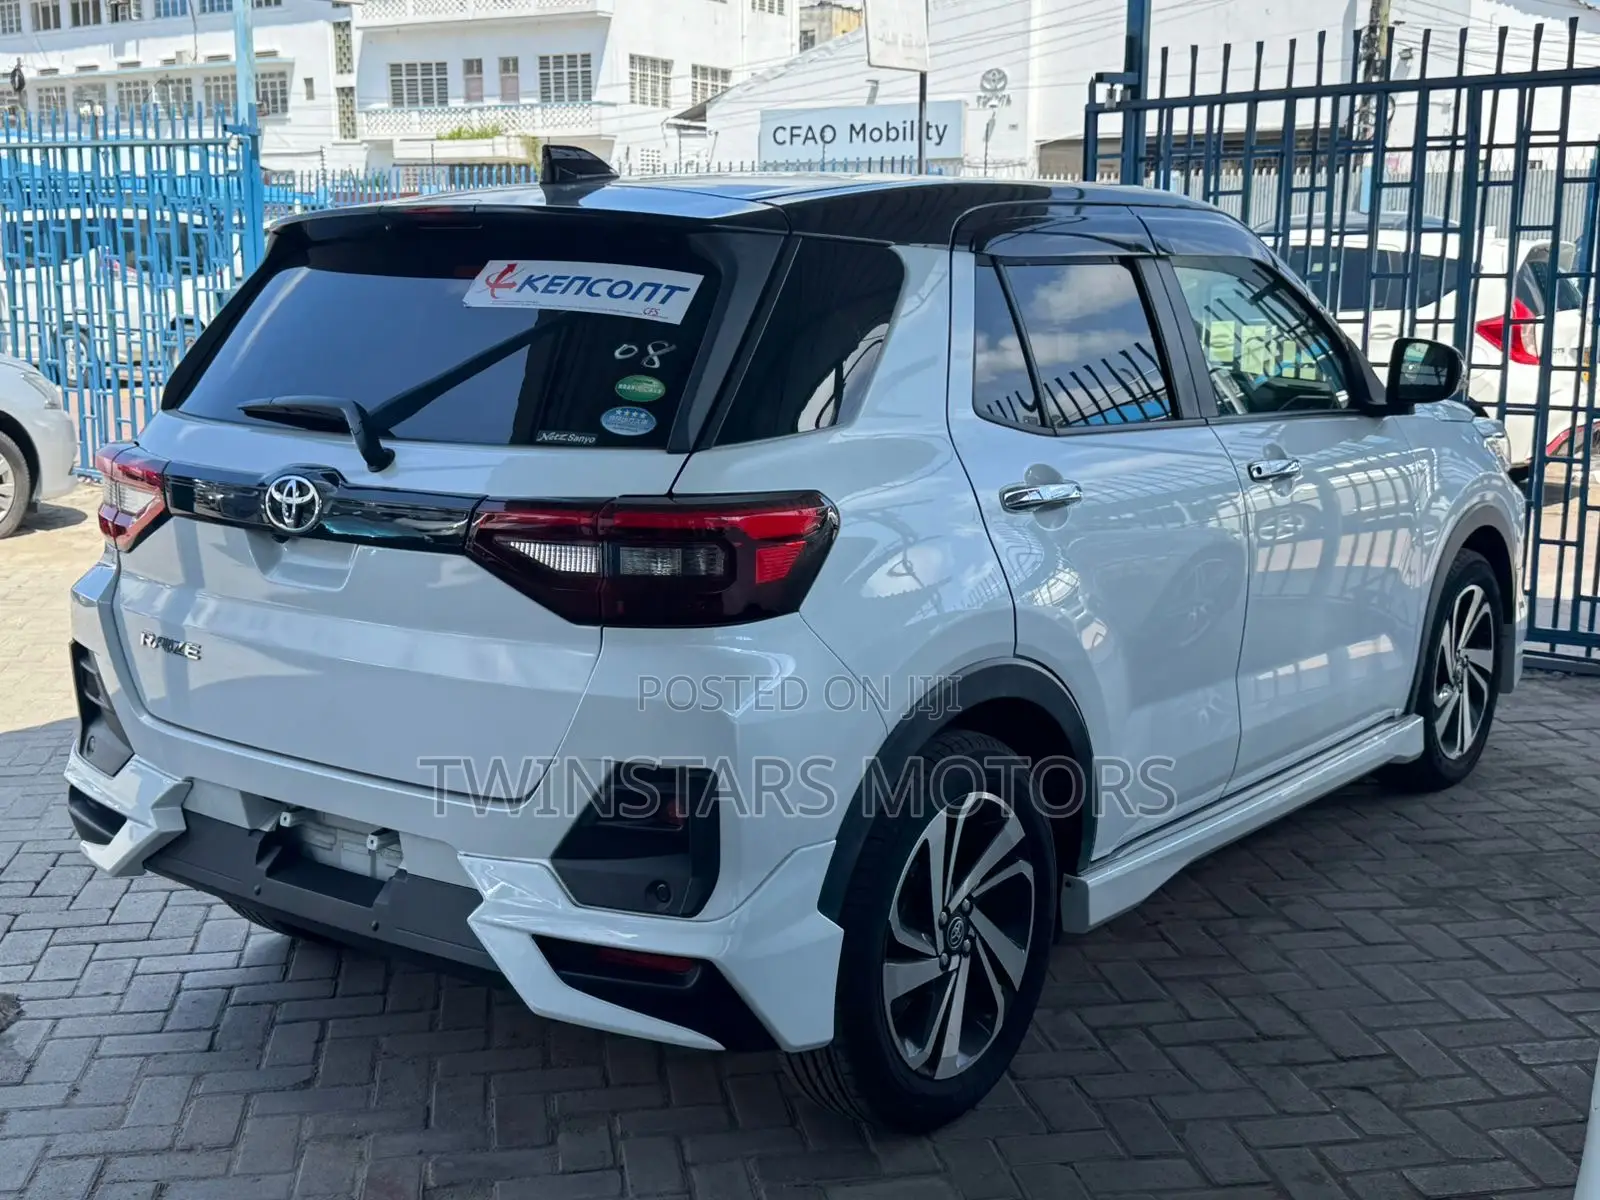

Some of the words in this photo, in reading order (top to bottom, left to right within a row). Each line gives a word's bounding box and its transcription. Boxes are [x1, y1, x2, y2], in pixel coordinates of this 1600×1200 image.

[976, 94, 1012, 107] TOTA
[772, 123, 837, 146] CFAO
[567, 433, 596, 445] Sanyo
